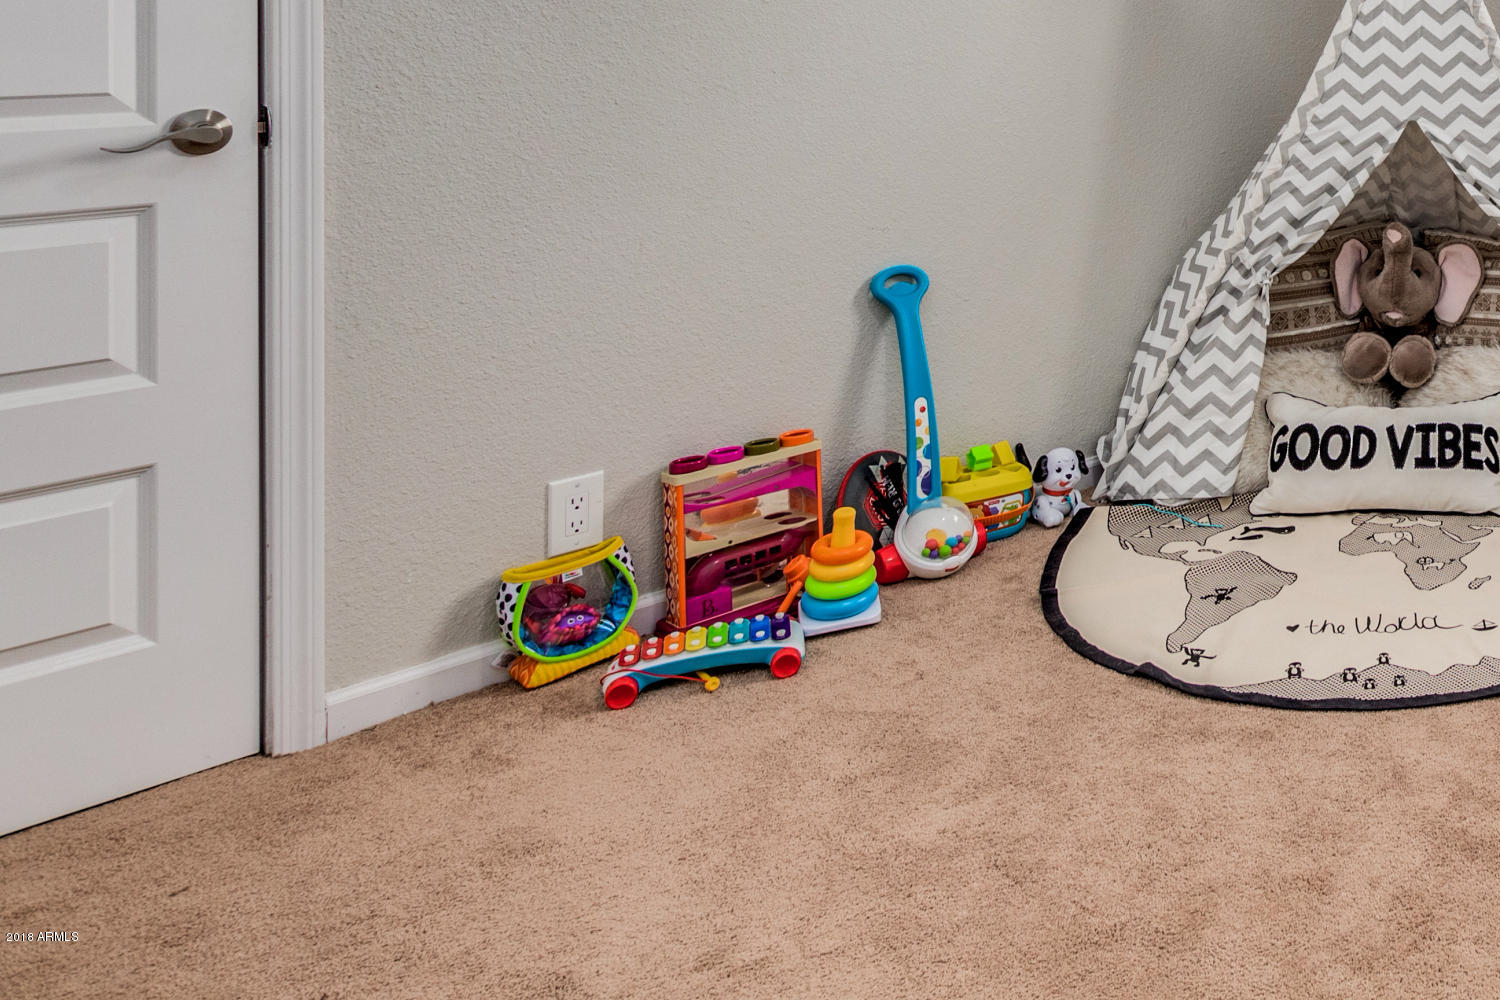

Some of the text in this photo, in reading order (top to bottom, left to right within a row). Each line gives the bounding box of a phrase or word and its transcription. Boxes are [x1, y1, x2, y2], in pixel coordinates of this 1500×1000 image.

[1270, 422, 1500, 475] GOOD VIBES
[1304, 618, 1346, 635] the
